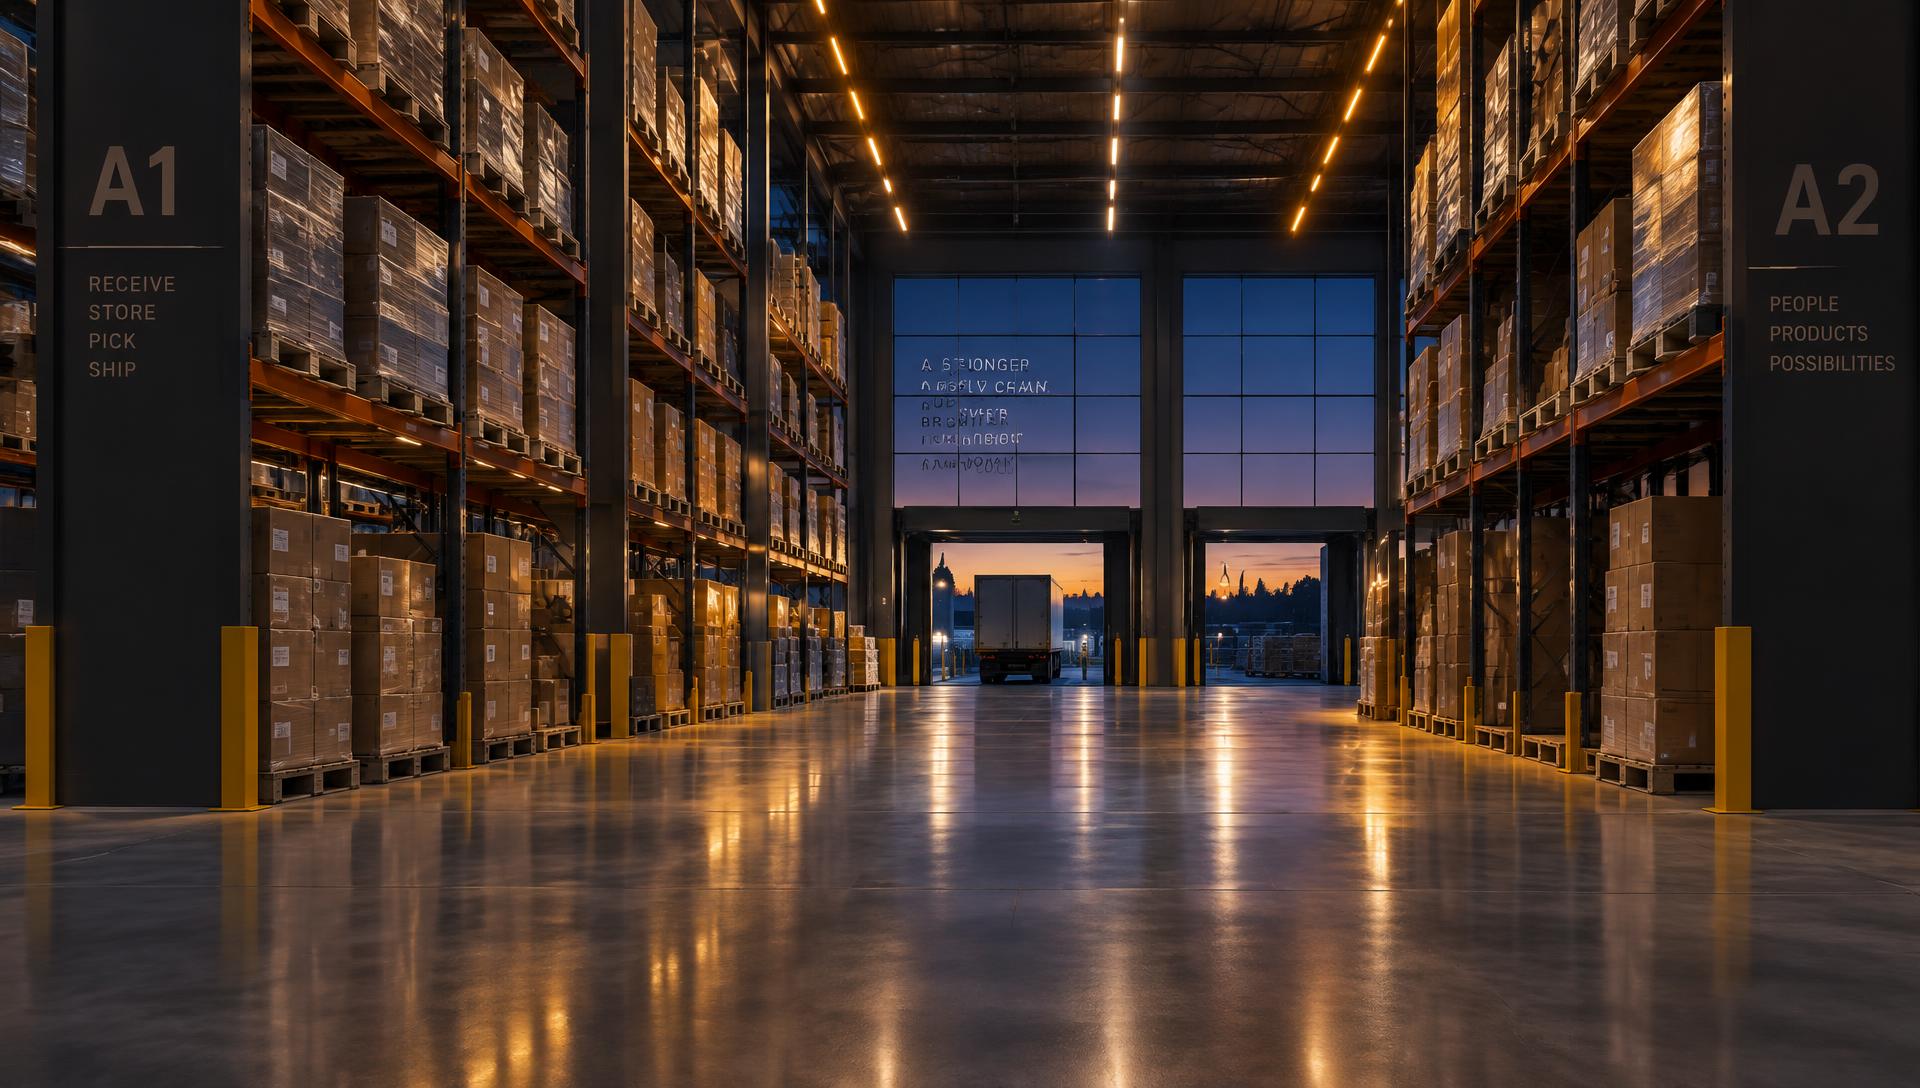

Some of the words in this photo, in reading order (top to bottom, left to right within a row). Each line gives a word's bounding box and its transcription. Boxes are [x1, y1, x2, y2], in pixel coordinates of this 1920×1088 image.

[88, 145, 176, 217] A1
[1775, 163, 1879, 236] A2
[89, 275, 176, 293] RECEIVE
[89, 303, 156, 321] STORE
[1769, 296, 1839, 313] PEOPLE
[89, 332, 137, 350] PICK
[1769, 325, 1869, 343] PRODUCTS
[89, 361, 137, 378] SHIP
[1769, 355, 1896, 372] POSSIBILITIES
